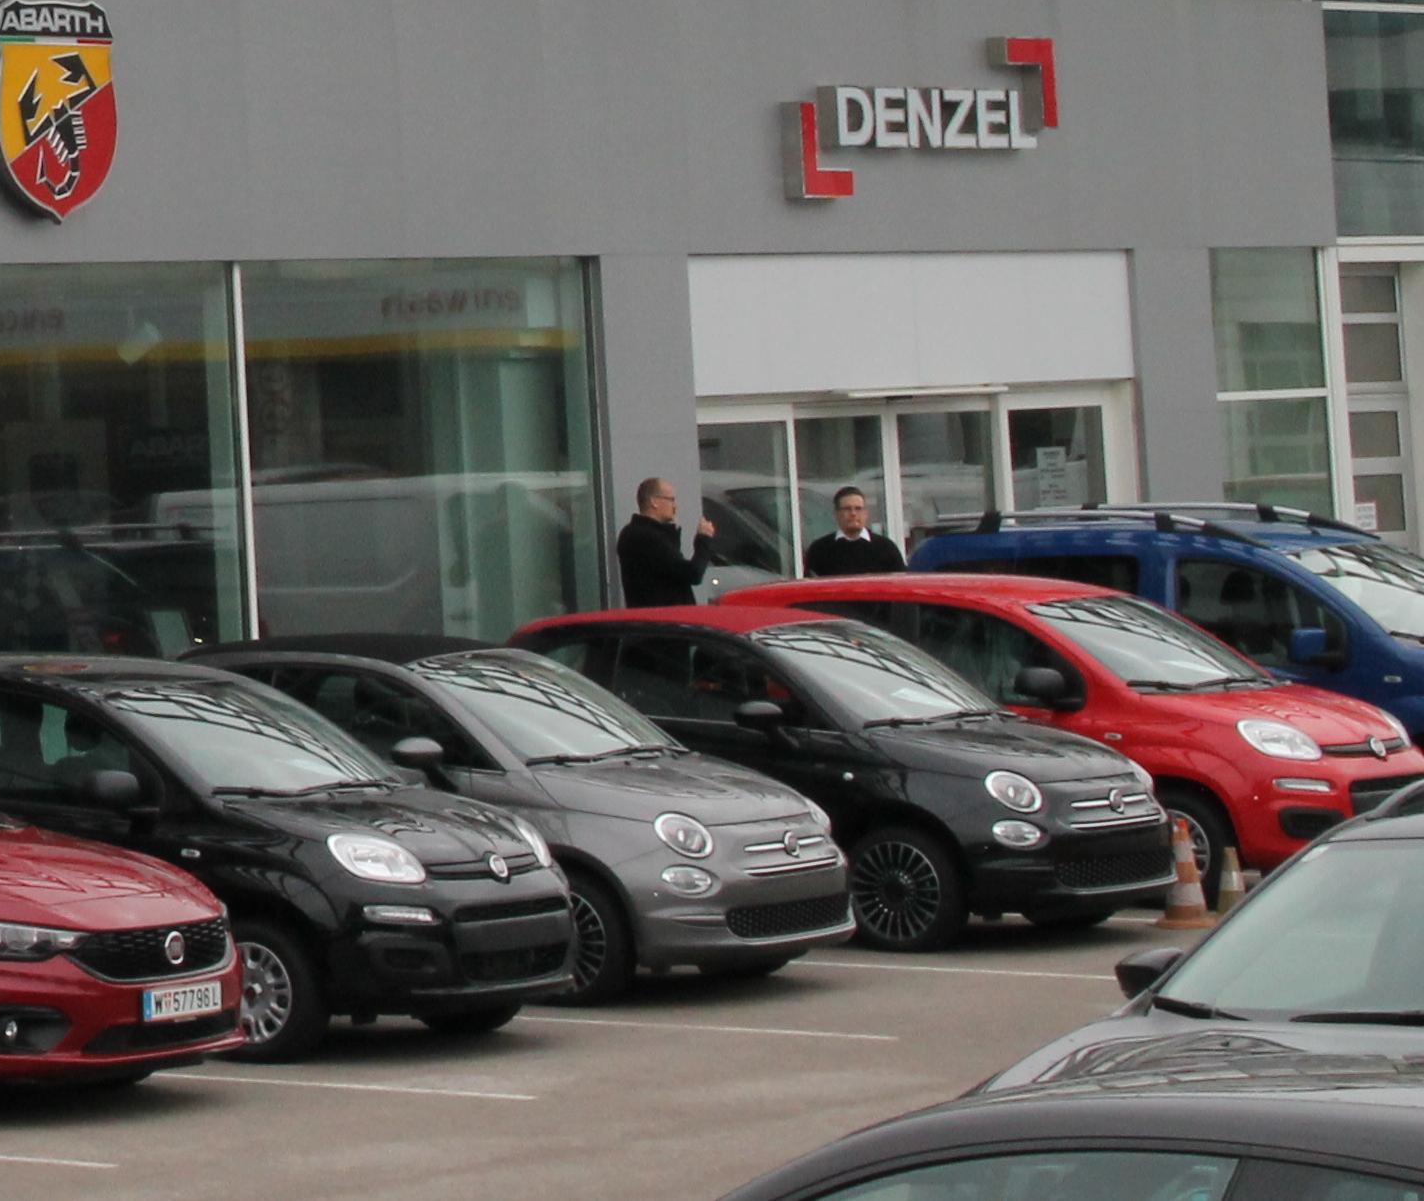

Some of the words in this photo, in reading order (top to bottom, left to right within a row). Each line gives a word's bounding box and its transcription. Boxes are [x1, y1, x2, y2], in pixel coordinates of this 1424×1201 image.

[2, 7, 103, 33] ABARTH
[836, 85, 1037, 148] DENZEL
[153, 992, 163, 1014] W
